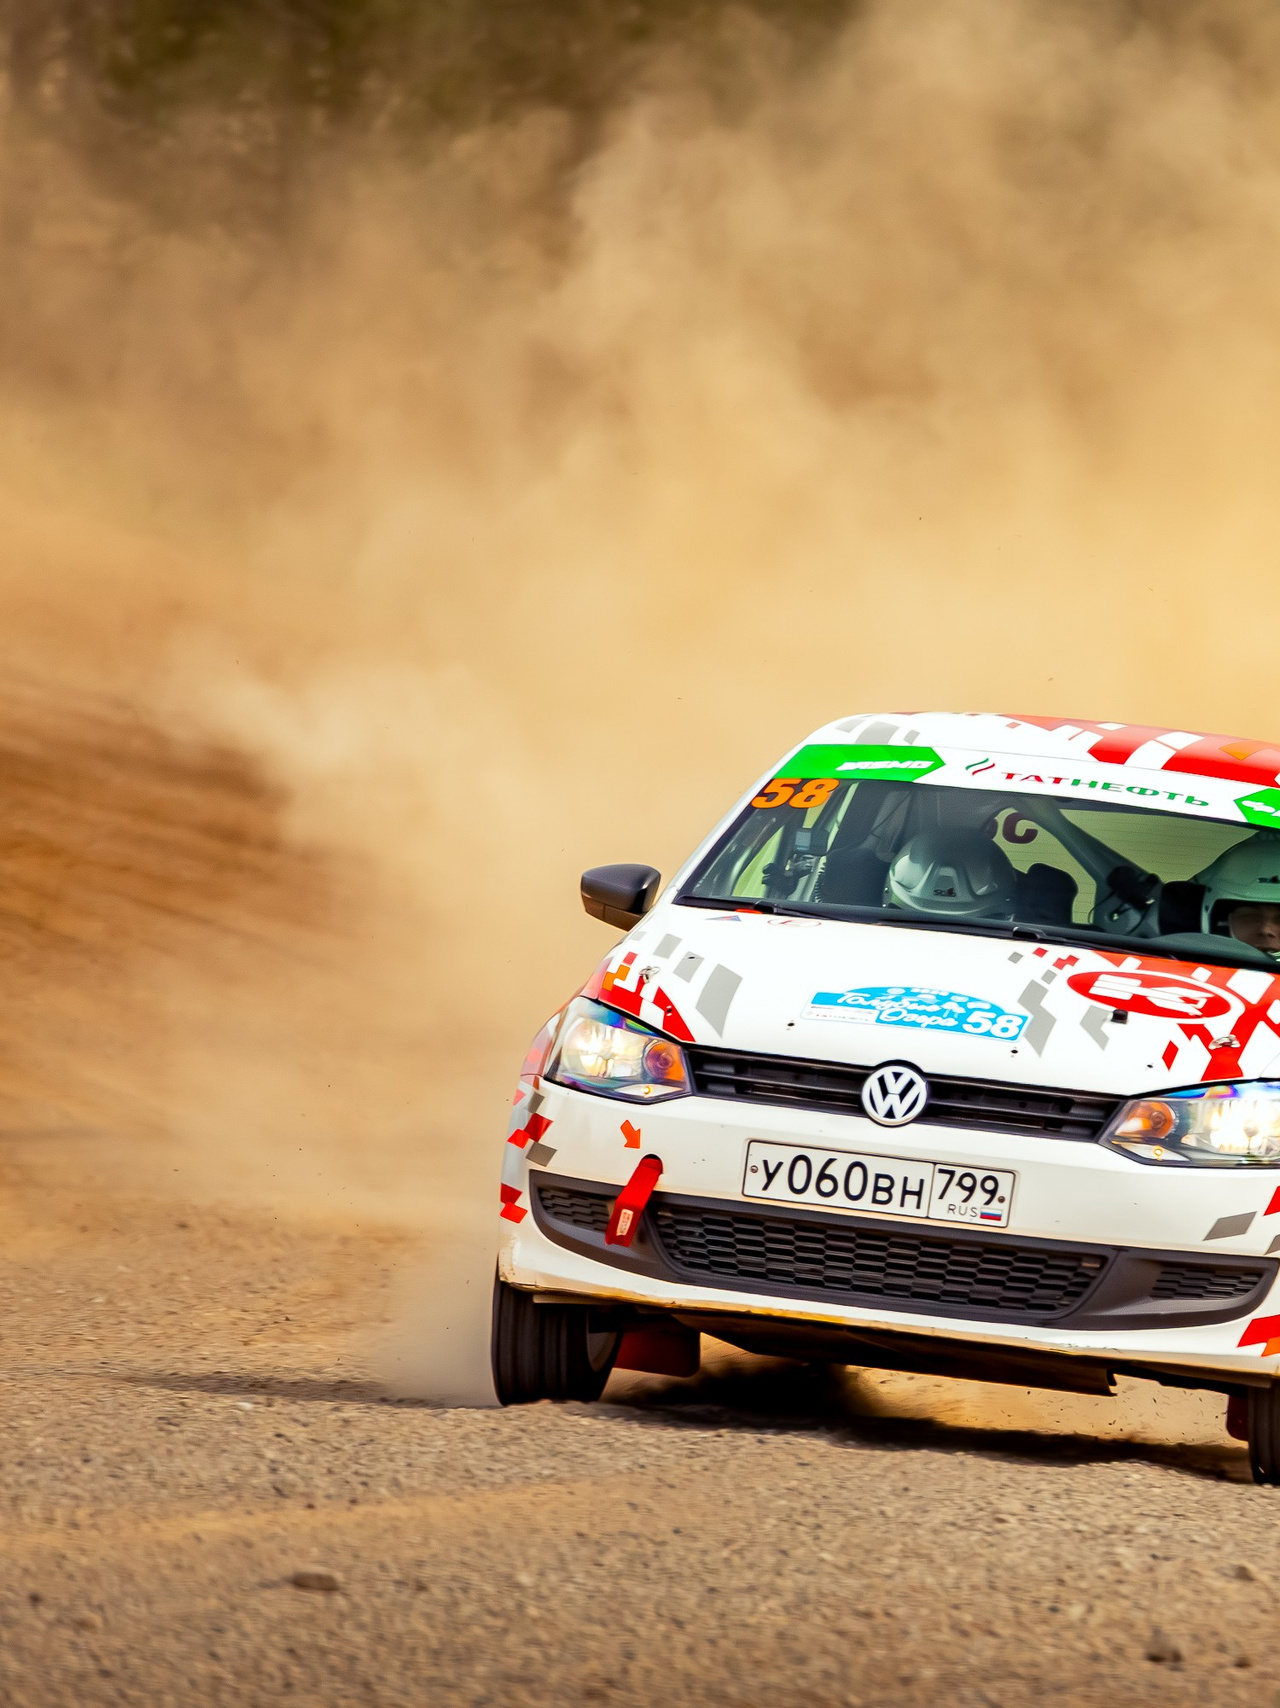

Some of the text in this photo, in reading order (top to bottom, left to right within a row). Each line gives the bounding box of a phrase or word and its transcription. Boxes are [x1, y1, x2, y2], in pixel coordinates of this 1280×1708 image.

[750, 778, 840, 809] 58
[1001, 772, 1209, 807] ТАТНЕФТЬ
[962, 1011, 1024, 1039] 58
[761, 1154, 1000, 1211] У060ВН 799
[946, 1203, 978, 1218] RUS
